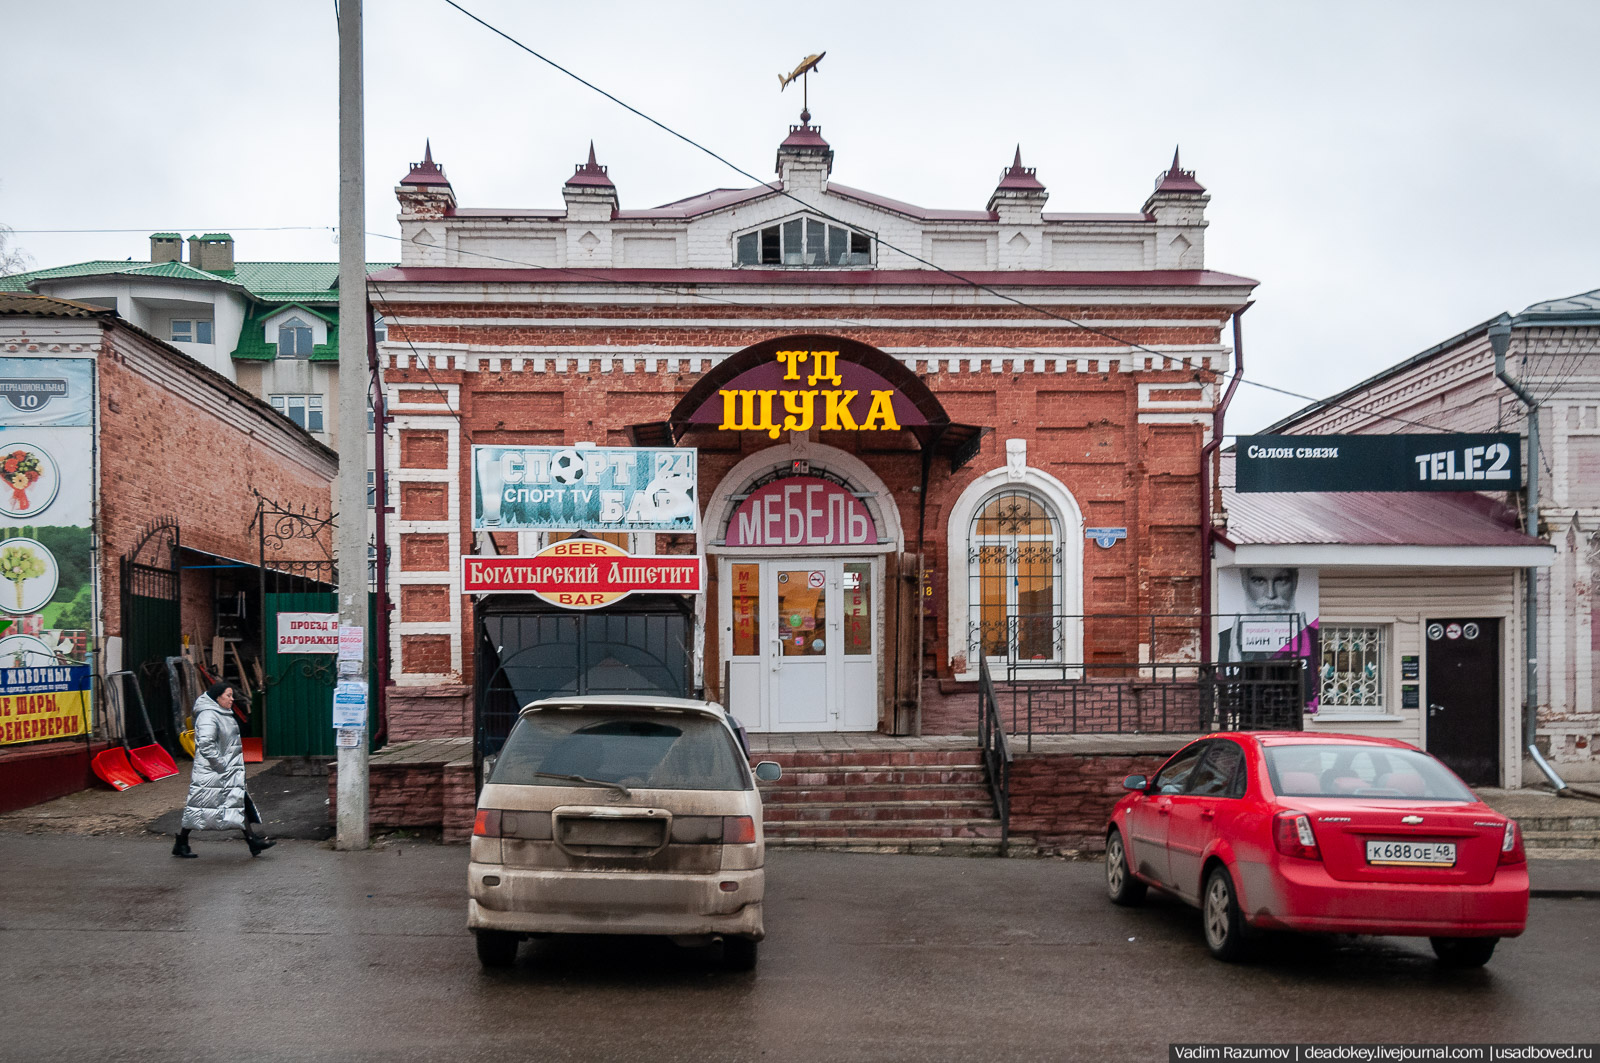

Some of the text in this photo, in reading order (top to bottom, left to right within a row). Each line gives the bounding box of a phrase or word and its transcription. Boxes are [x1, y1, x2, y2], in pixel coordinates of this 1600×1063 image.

[776, 351, 842, 387] ТД
[0, 383, 65, 392] ТЕРНАЦИОНАЛЬНАЯ
[19, 395, 38, 408] 10
[718, 389, 901, 440] ЩУКА
[1247, 445, 1339, 459] Салон связи
[1415, 443, 1511, 481] TELE2
[504, 489, 593, 503] СПОРТ TV
[738, 485, 867, 545] МЕБЕЛЬ
[554, 543, 607, 555] BEER
[470, 562, 694, 584] Богатырский Аппетит
[559, 593, 604, 605] BAR
[738, 571, 750, 639] МЕБЕЛЬ
[852, 573, 863, 645] МЕБЕЛЬ
[290, 621, 328, 631] ПРОЕЗД
[1274, 627, 1296, 635] купиь
[7, 667, 71, 685] ЖИВОТНЫХ
[16, 694, 60, 716] ШАРЫ,
